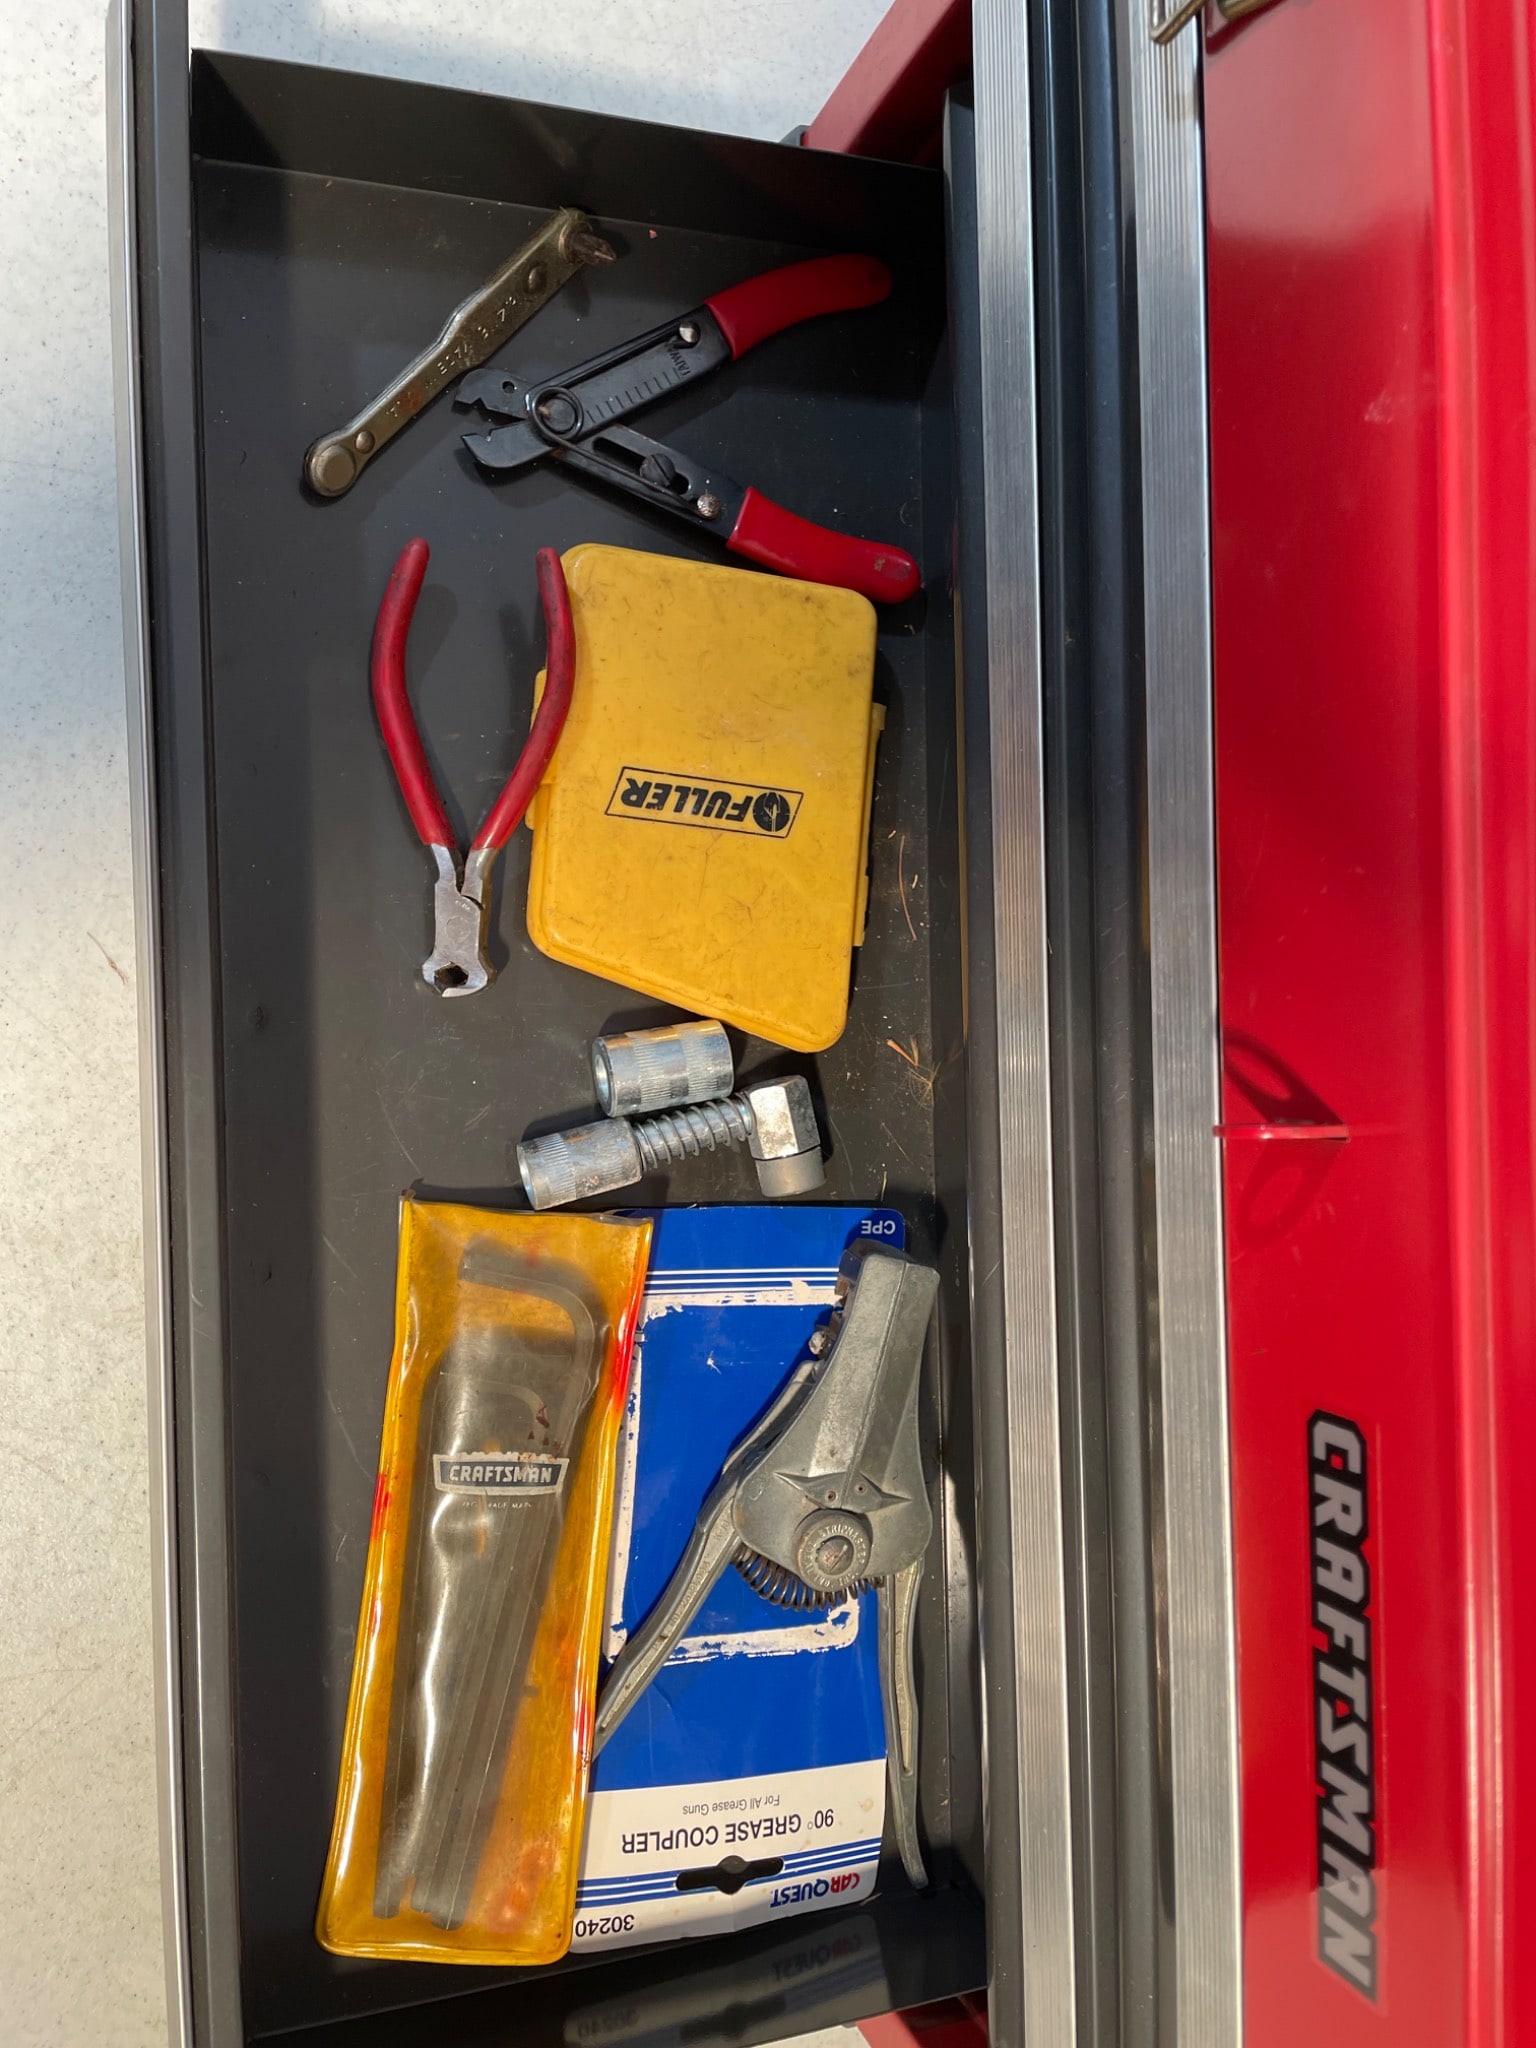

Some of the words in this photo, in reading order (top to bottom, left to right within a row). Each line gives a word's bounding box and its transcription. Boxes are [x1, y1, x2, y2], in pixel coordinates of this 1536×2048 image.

[620, 777, 754, 823] FULLER
[861, 1219, 896, 1235] CPE
[448, 1464, 553, 1484] CRAFTSMAN
[1308, 1410, 1378, 1999] CRAFTSMAN
[682, 1802, 710, 1816] Guns
[710, 1798, 748, 1812] Grease
[750, 1796, 762, 1810] All
[764, 1794, 781, 1807] For
[621, 1824, 719, 1854] COUPLER
[724, 1813, 802, 1844] GREASE
[769, 1871, 861, 1909] CARQUEST
[574, 1913, 635, 1938] 30240
